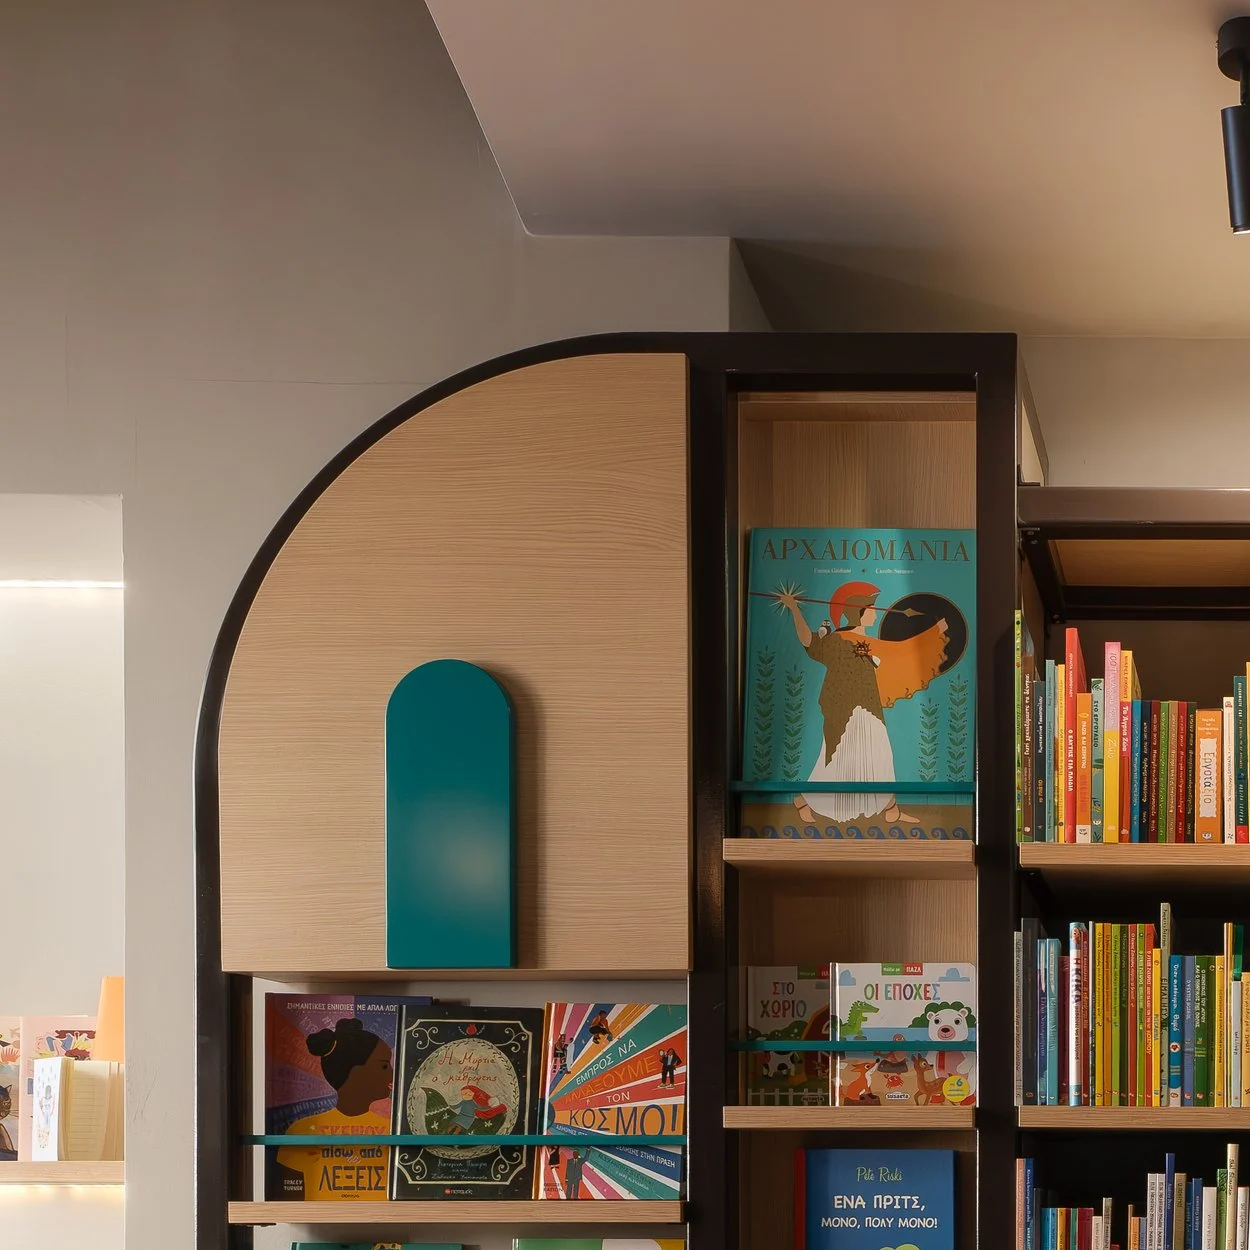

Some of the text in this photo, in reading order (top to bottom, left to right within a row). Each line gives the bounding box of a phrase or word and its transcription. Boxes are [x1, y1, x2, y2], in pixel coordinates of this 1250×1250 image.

[762, 539, 970, 561] ΑΡΧΑΙΟΜΑΝΙΑ
[1204, 742, 1217, 795] Εργοτάξιο
[773, 982, 795, 996] ΣΤΟ
[864, 984, 941, 1001] ΟΙ ΕΠΟΧΕΣ
[761, 1000, 807, 1018] ΧΩΡΙΟ
[575, 1039, 638, 1086] ΕΜΠΡΟΣ ΝΑ
[565, 1055, 658, 1103] ΑΛΛΑΞΟΥΜΕ
[606, 1092, 631, 1104] ΤΟΝ
[569, 1104, 679, 1136] ΚΟΣΜΟ!
[360, 1147, 383, 1159] από
[319, 1165, 386, 1192] ΛΕΞΕΙΣ
[834, 1196, 926, 1211] ΕΝΑ ΠΡΙΤΣ,
[821, 1218, 938, 1229] ΜΟΝΟ, ΠΟΛΥ ΜΟΝΟ!
